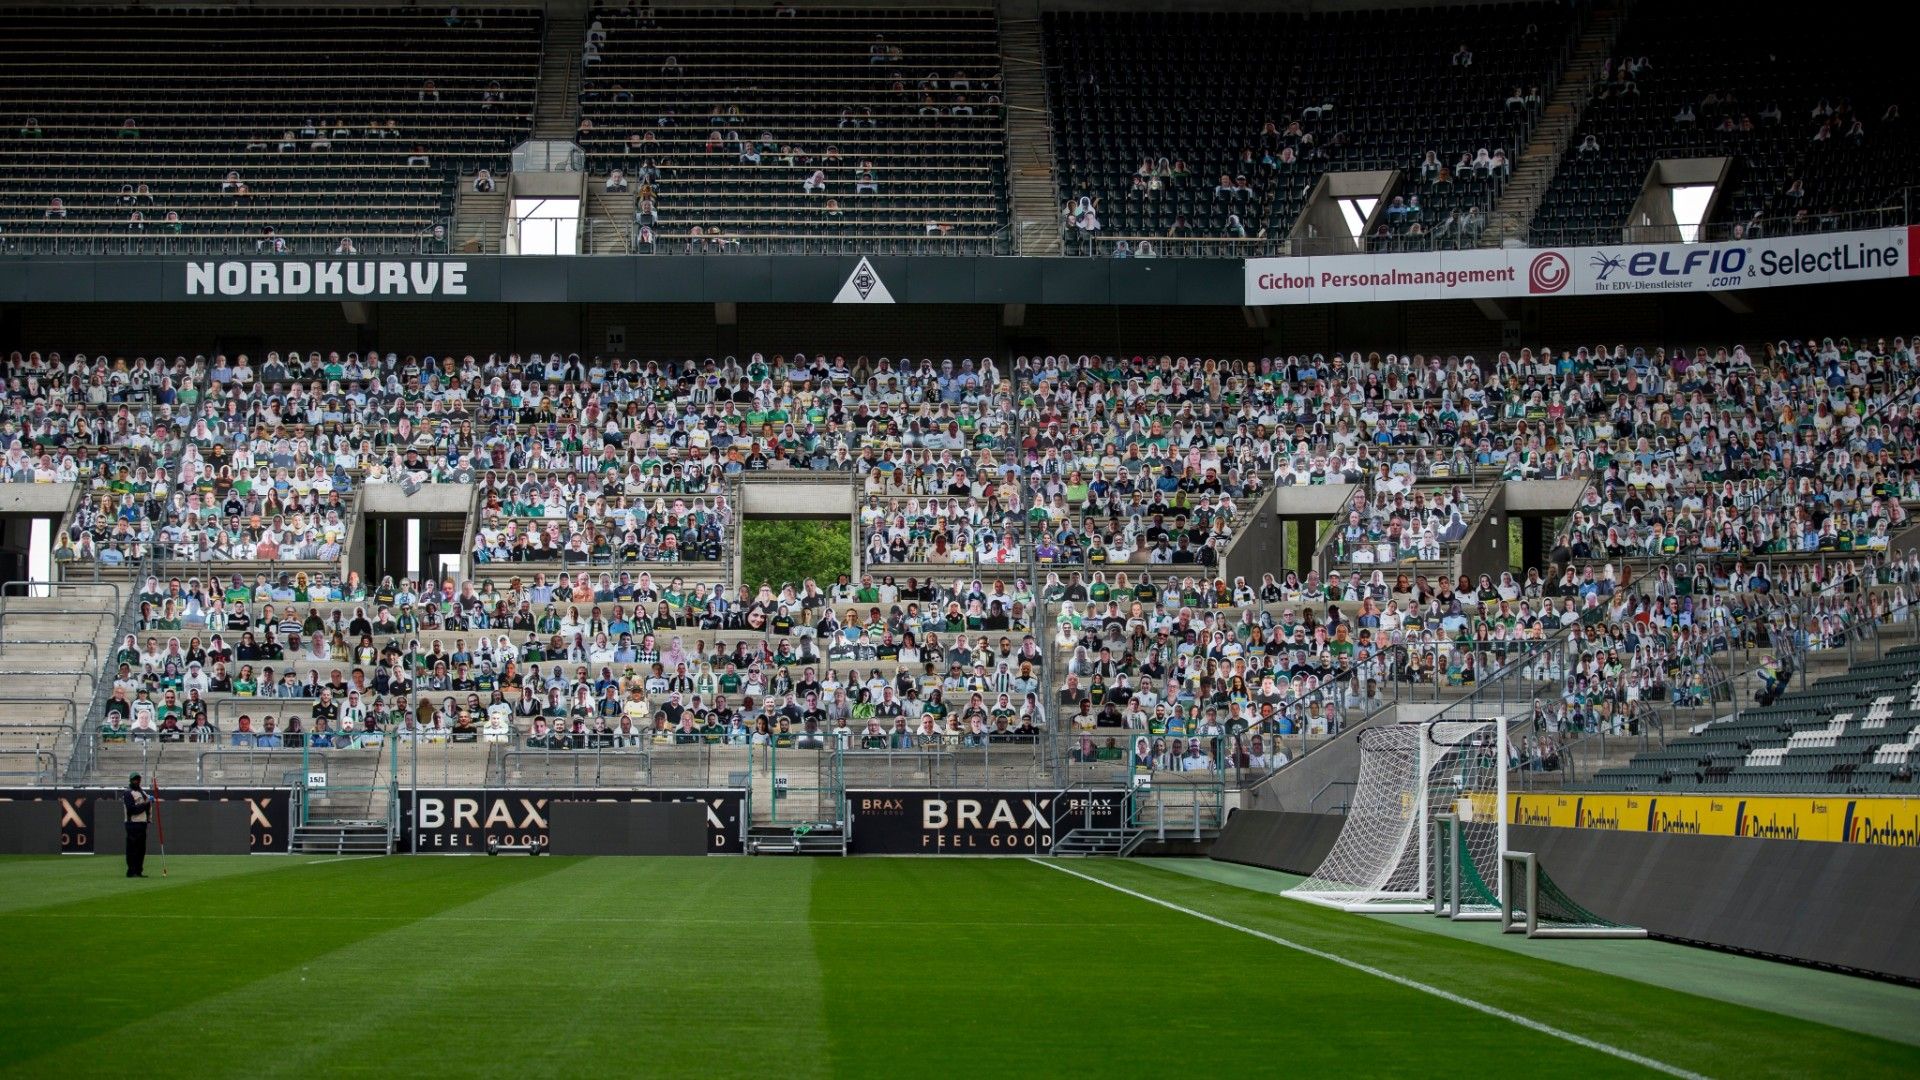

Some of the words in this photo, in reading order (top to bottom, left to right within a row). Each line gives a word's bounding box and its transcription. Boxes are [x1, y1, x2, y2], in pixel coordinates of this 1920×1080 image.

[1747, 264, 1756, 277] &
[1760, 243, 1899, 276] SelectLine
[186, 261, 468, 296] NORDKURVE
[1257, 272, 1315, 290] Cichon
[1321, 265, 1515, 288] Personalmanagement
[1595, 281, 1609, 290] Ihr
[1612, 279, 1694, 290] EDV-Dienstleister
[1706, 275, 1741, 287] .com
[419, 798, 548, 829] BRAX
[862, 799, 904, 810] BRAX
[922, 799, 1052, 830] BRAX
[419, 833, 474, 847] FEEL
[487, 833, 549, 847] GOOD
[922, 834, 976, 847] FEEL
[990, 834, 1053, 847] GOOD
